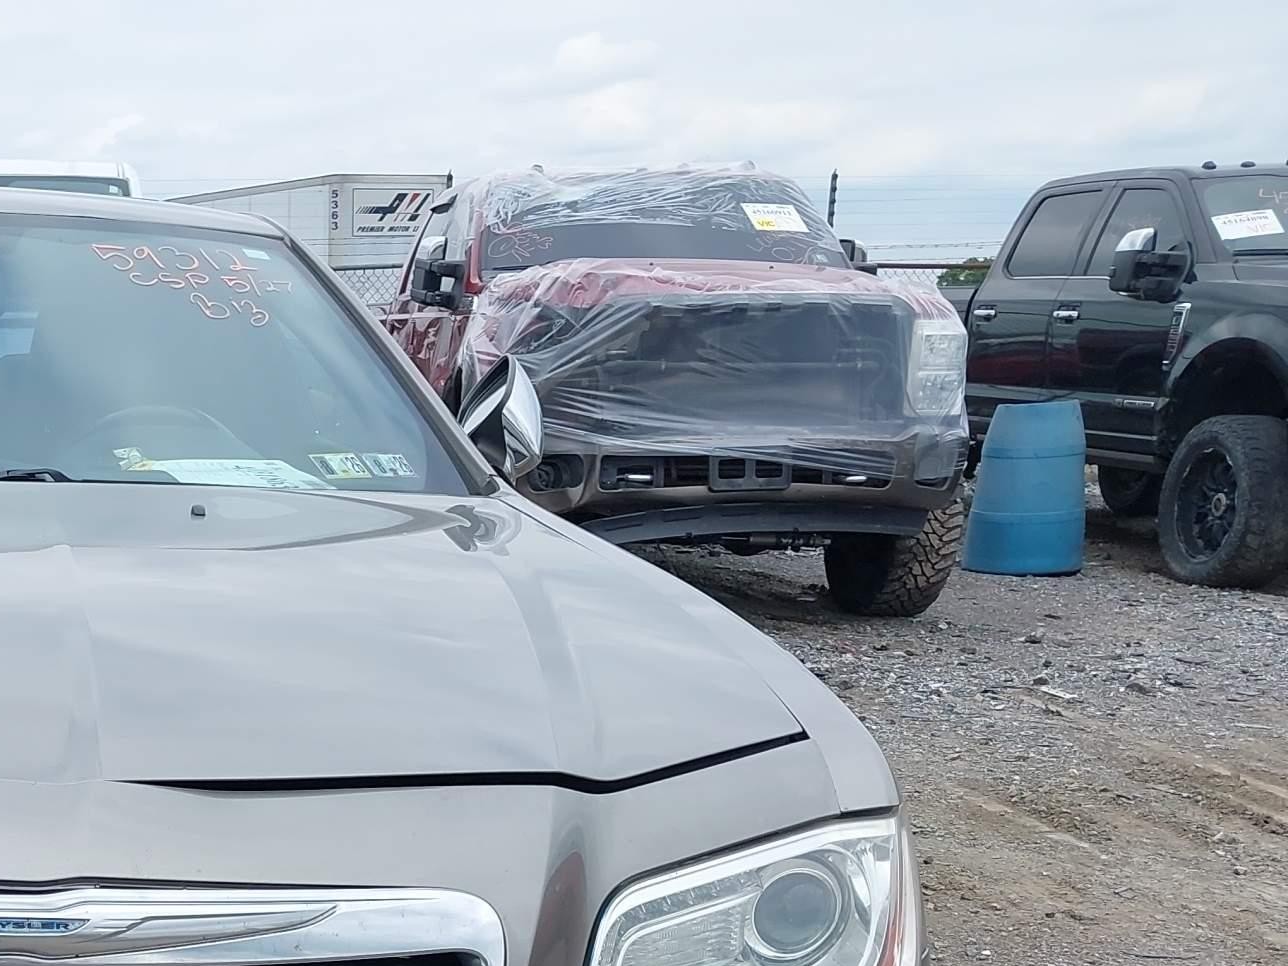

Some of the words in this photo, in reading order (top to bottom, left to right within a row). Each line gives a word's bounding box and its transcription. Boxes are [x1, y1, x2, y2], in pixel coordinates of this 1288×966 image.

[331, 189, 339, 231] 5363
[356, 225, 385, 233] PREMIER
[387, 225, 410, 233] MOTOR
[92, 243, 258, 271] 59312
